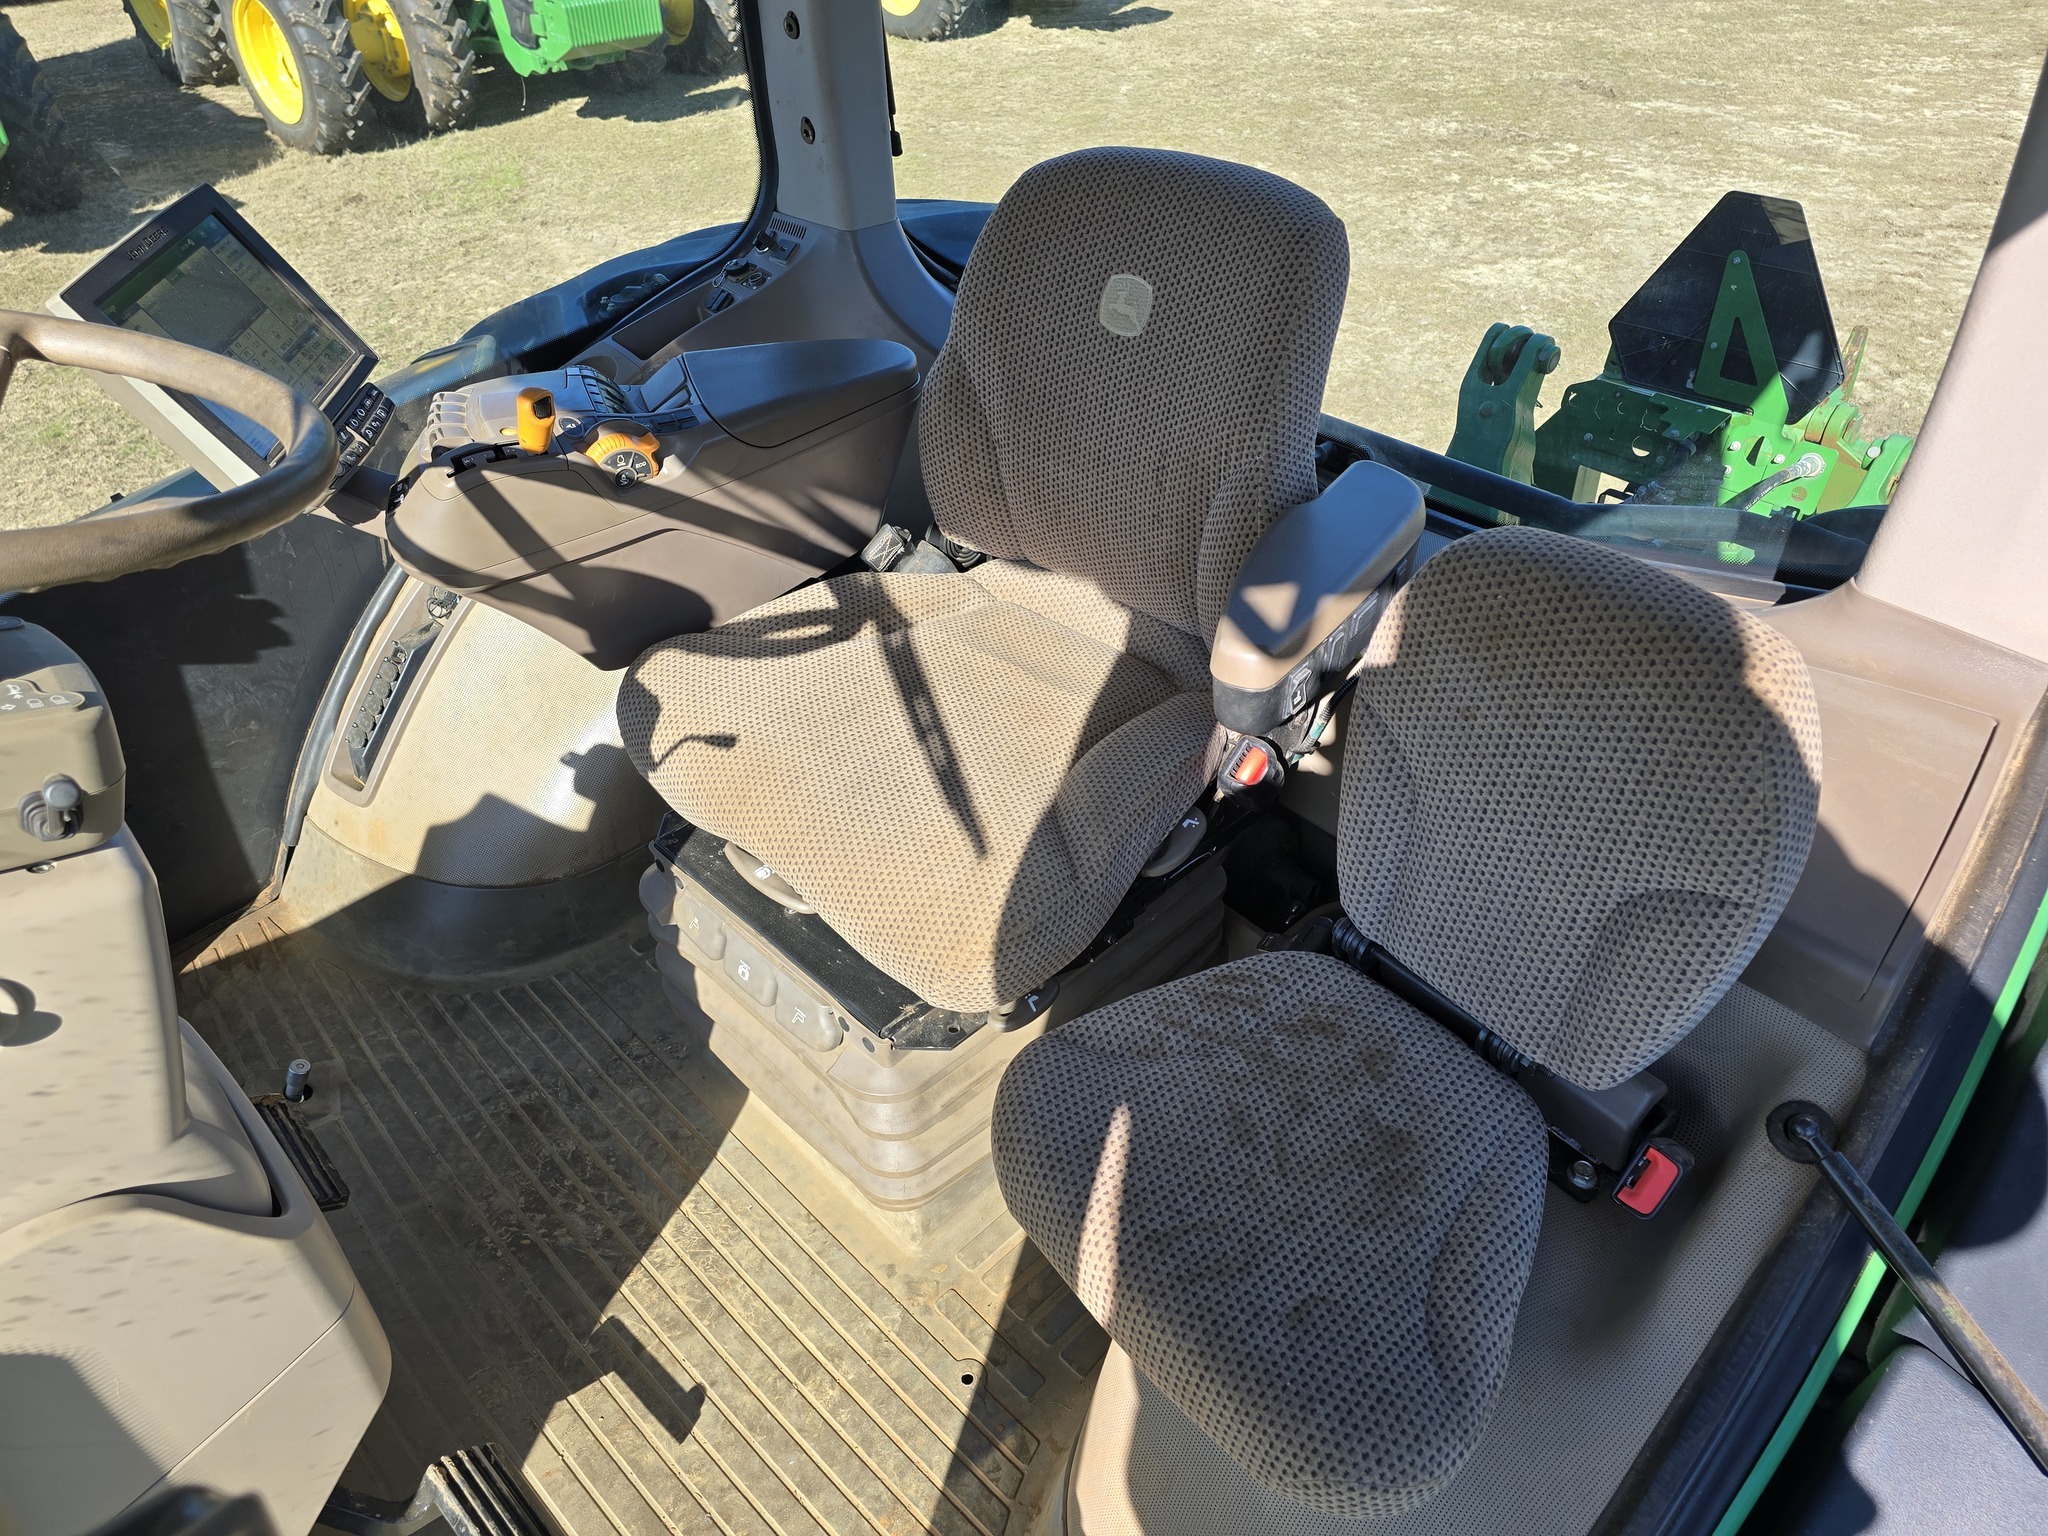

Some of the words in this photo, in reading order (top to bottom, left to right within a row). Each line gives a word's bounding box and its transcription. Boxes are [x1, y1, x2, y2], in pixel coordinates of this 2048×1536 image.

[126, 241, 150, 261] JOHN
[143, 226, 169, 246] DEERE
[635, 461, 647, 469] ECO
